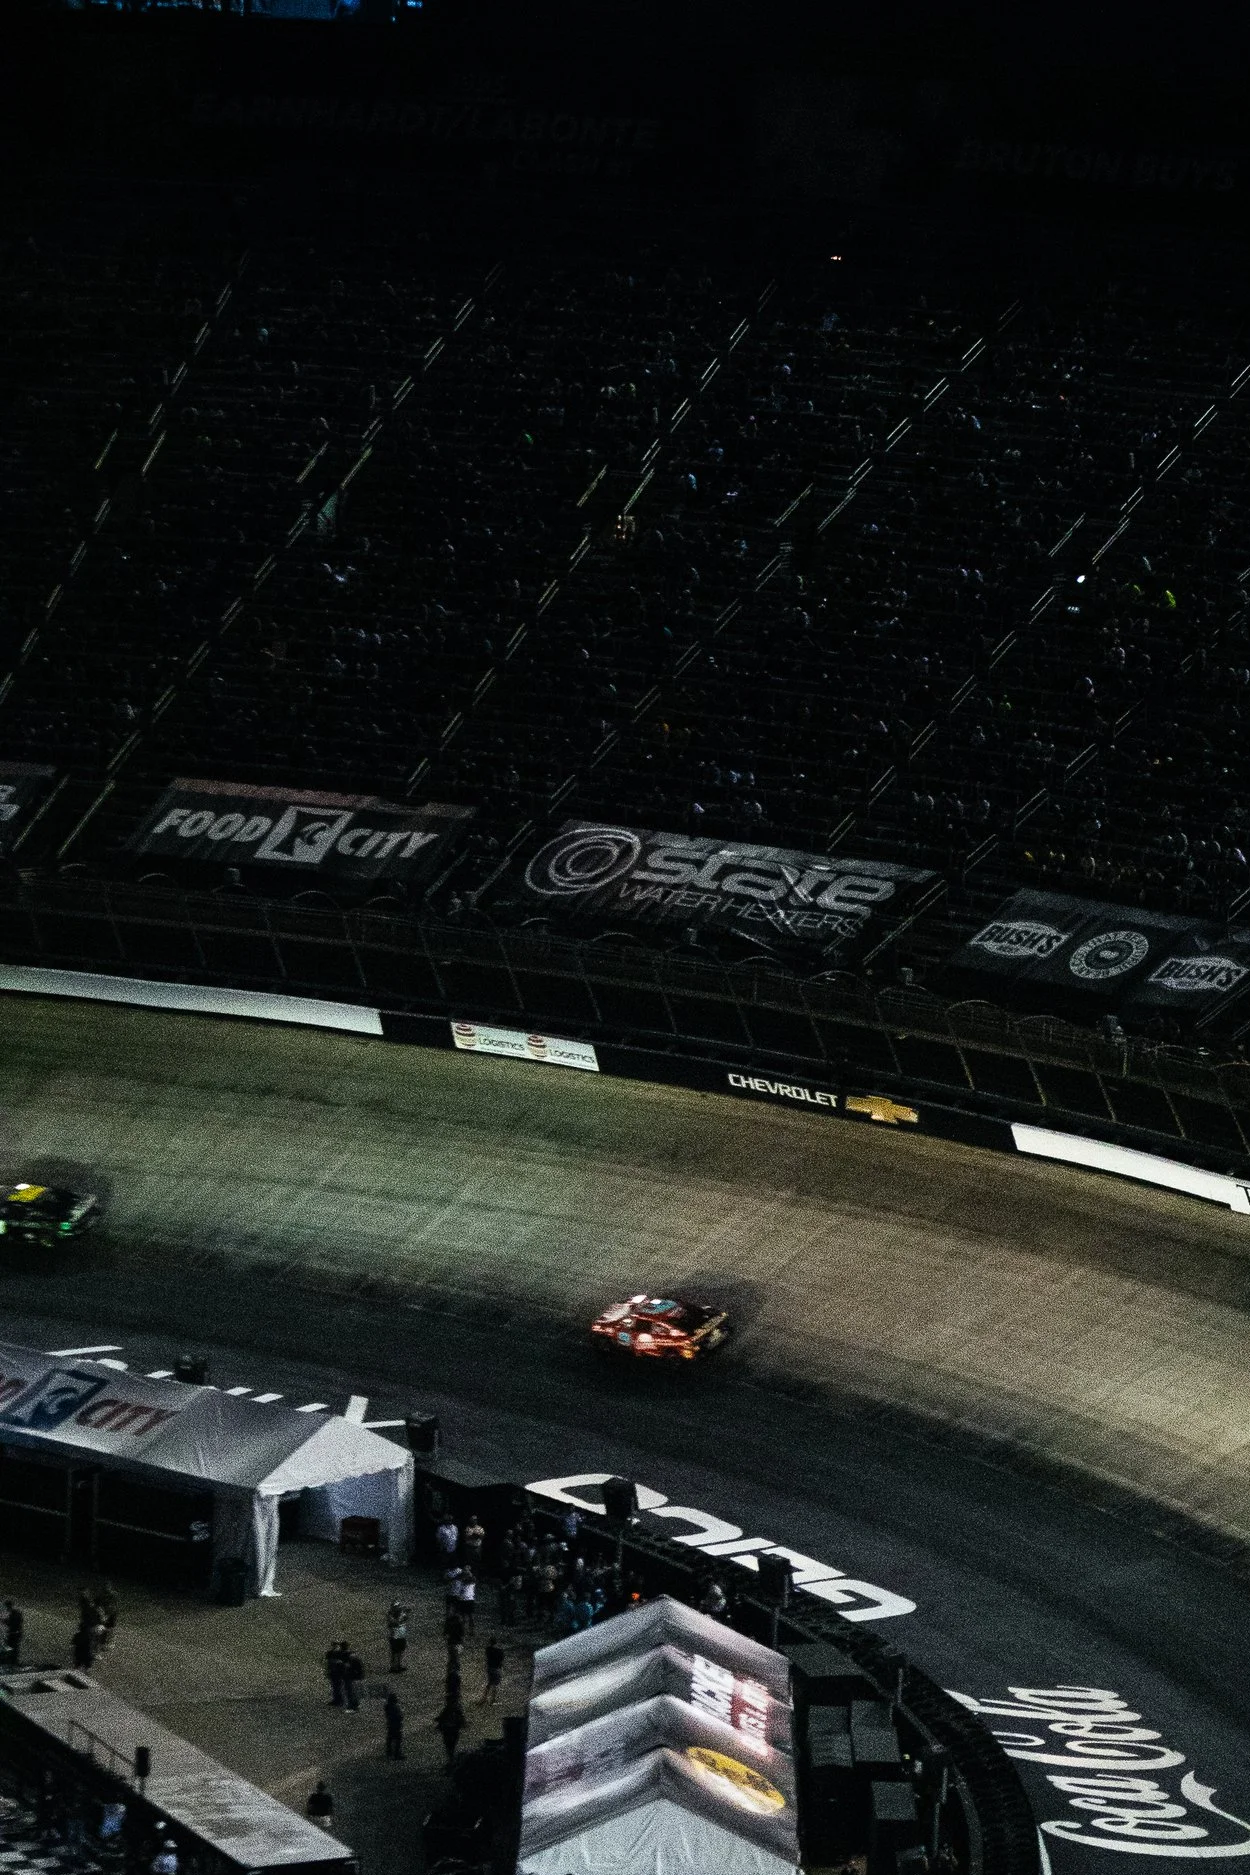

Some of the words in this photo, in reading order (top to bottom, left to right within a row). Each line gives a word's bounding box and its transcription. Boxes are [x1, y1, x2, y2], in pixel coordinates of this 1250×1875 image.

[954, 135, 1124, 183] BRUTON
[1132, 155, 1239, 193] BUYS
[153, 807, 270, 844] FOOD
[332, 826, 441, 861] CITY
[617, 882, 720, 912] WATER
[727, 1073, 839, 1108] CHEVROLET
[75, 1400, 182, 1438] CITY
[524, 1472, 918, 1624] GEICO
